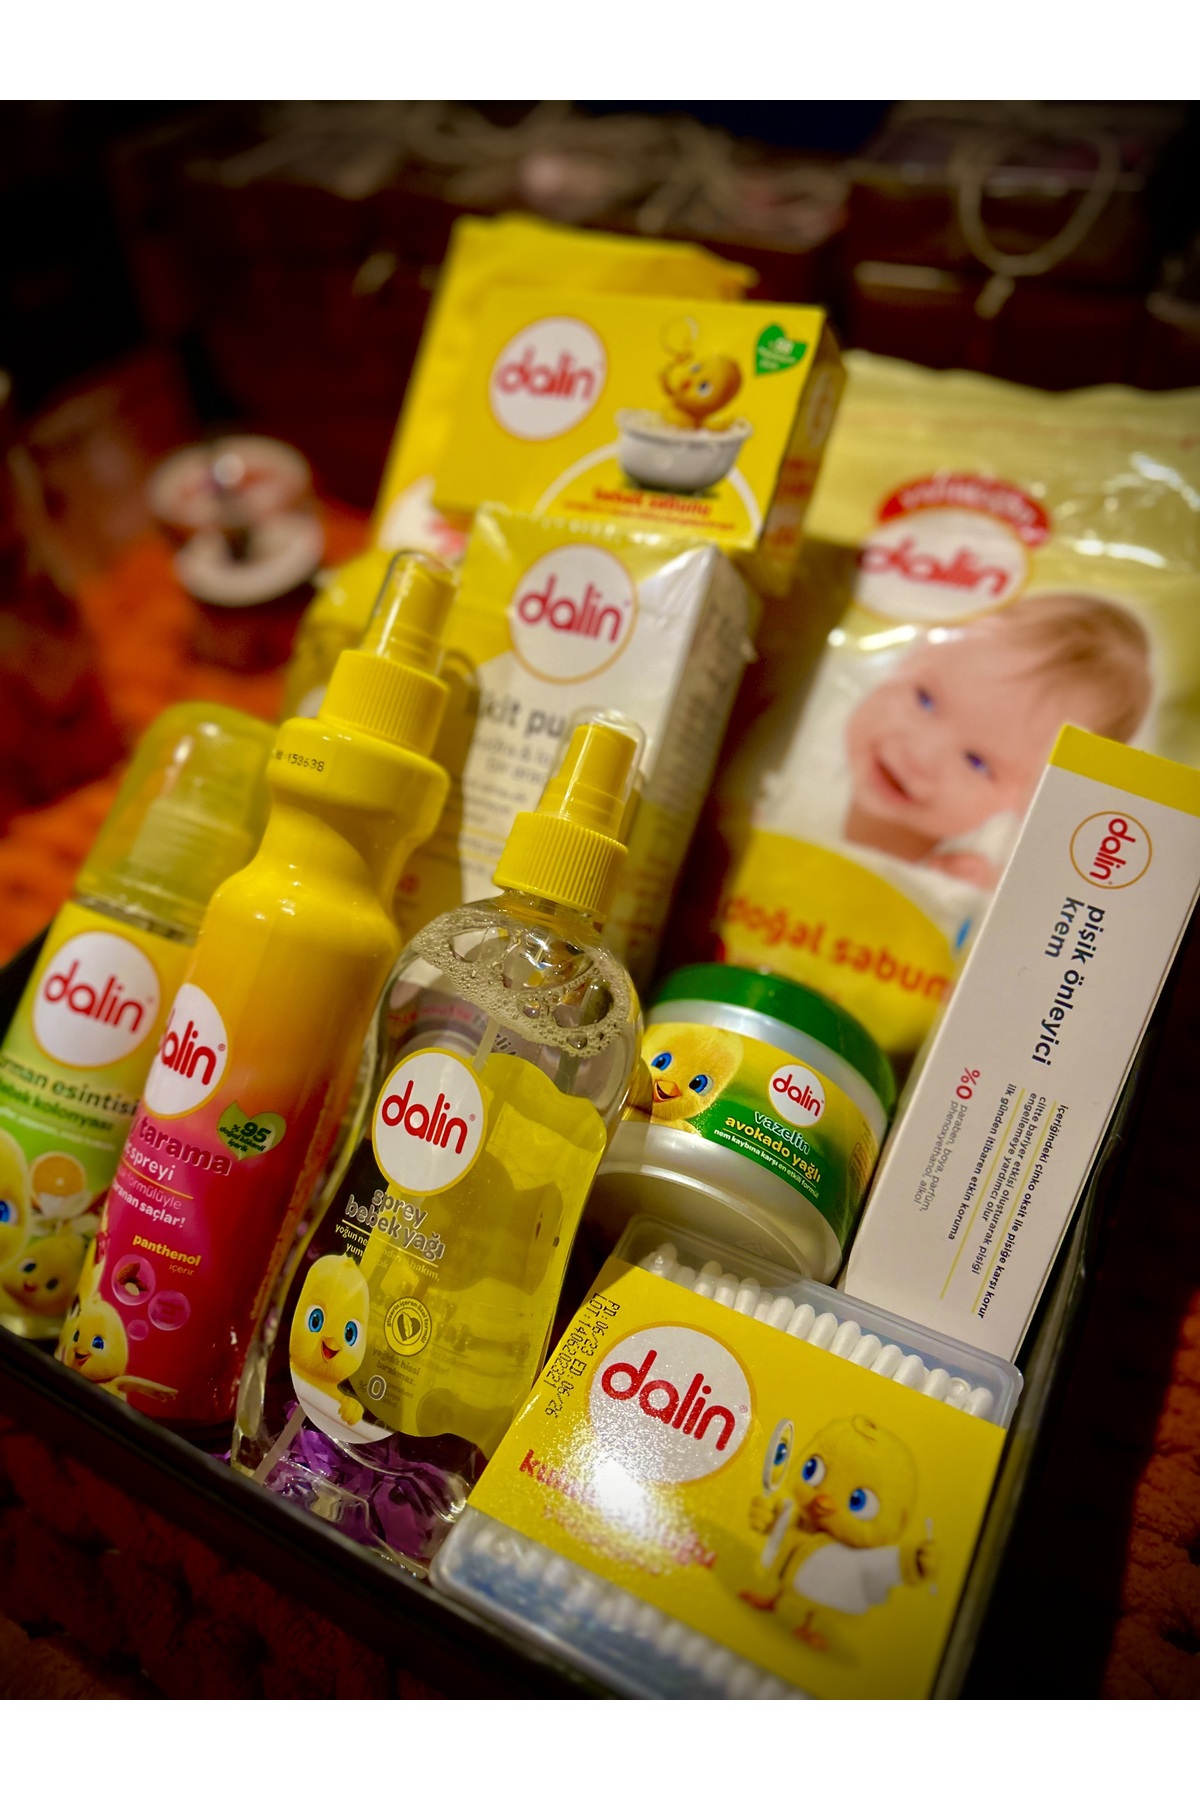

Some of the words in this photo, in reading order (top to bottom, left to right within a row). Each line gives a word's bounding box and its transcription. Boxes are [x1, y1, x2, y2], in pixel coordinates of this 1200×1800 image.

[497, 343, 595, 401] dalin
[856, 536, 1010, 599] dalin
[517, 574, 624, 644] dalin
[1089, 818, 1136, 881] dalin
[728, 896, 827, 955] doğal
[1044, 896, 1085, 958] krem
[1070, 904, 1106, 965] pişik
[43, 959, 145, 1034] dalin
[1031, 969, 1085, 1066] önleyici
[161, 1009, 217, 1086] alin
[52, 1080, 140, 1117] esintisi
[772, 1073, 821, 1117] dalin
[955, 1067, 981, 1100] %0
[1004, 1083, 1017, 1097] ilk
[381, 1079, 468, 1155] dalin
[945, 1104, 968, 1146] paraben,
[990, 1097, 1009, 1135] günden
[1007, 1092, 1037, 1155] engellemeye
[1031, 1096, 1047, 1123] ciltte
[139, 1116, 233, 1177] tarama
[713, 1129, 731, 1141] nem
[731, 1135, 761, 1156] kaybına
[760, 1152, 779, 1166] karşı
[778, 1164, 787, 1172] en
[725, 1116, 791, 1158] avokado
[791, 1153, 821, 1183] yağlı
[754, 1111, 811, 1155] vazelin
[1017, 1123, 1037, 1160] bariyer
[1039, 1104, 1069, 1163] içeriğindeki
[128, 1146, 176, 1181] spreyi
[934, 1147, 953, 1173] boya,
[973, 1136, 996, 1175] itibaren
[1007, 1161, 1021, 1189] etkisi
[913, 1179, 928, 1205] alkol
[919, 1175, 940, 1212] parfüm,
[963, 1175, 978, 1202] etkin
[990, 1155, 1013, 1200] yardımcı
[1027, 1163, 1044, 1191] çinko
[139, 1203, 186, 1228] saçlar!
[371, 1189, 429, 1230] sprey
[948, 1202, 970, 1240] koruma
[981, 1200, 994, 1222] olur
[982, 1189, 1010, 1246] oluşturarak
[1011, 1218, 1024, 1232] ile
[1016, 1192, 1032, 1218] oksit
[344, 1194, 403, 1240] bebek
[402, 1226, 446, 1262] yağı
[998, 1232, 1016, 1264] pişiğe
[132, 1235, 203, 1267] panthenol
[335, 1223, 358, 1242] yoğun
[410, 1259, 441, 1282] bakım,
[971, 1245, 987, 1275] pişiği
[988, 1264, 1005, 1290] karşı
[977, 1290, 995, 1319] korur
[601, 1349, 737, 1452] dalin
